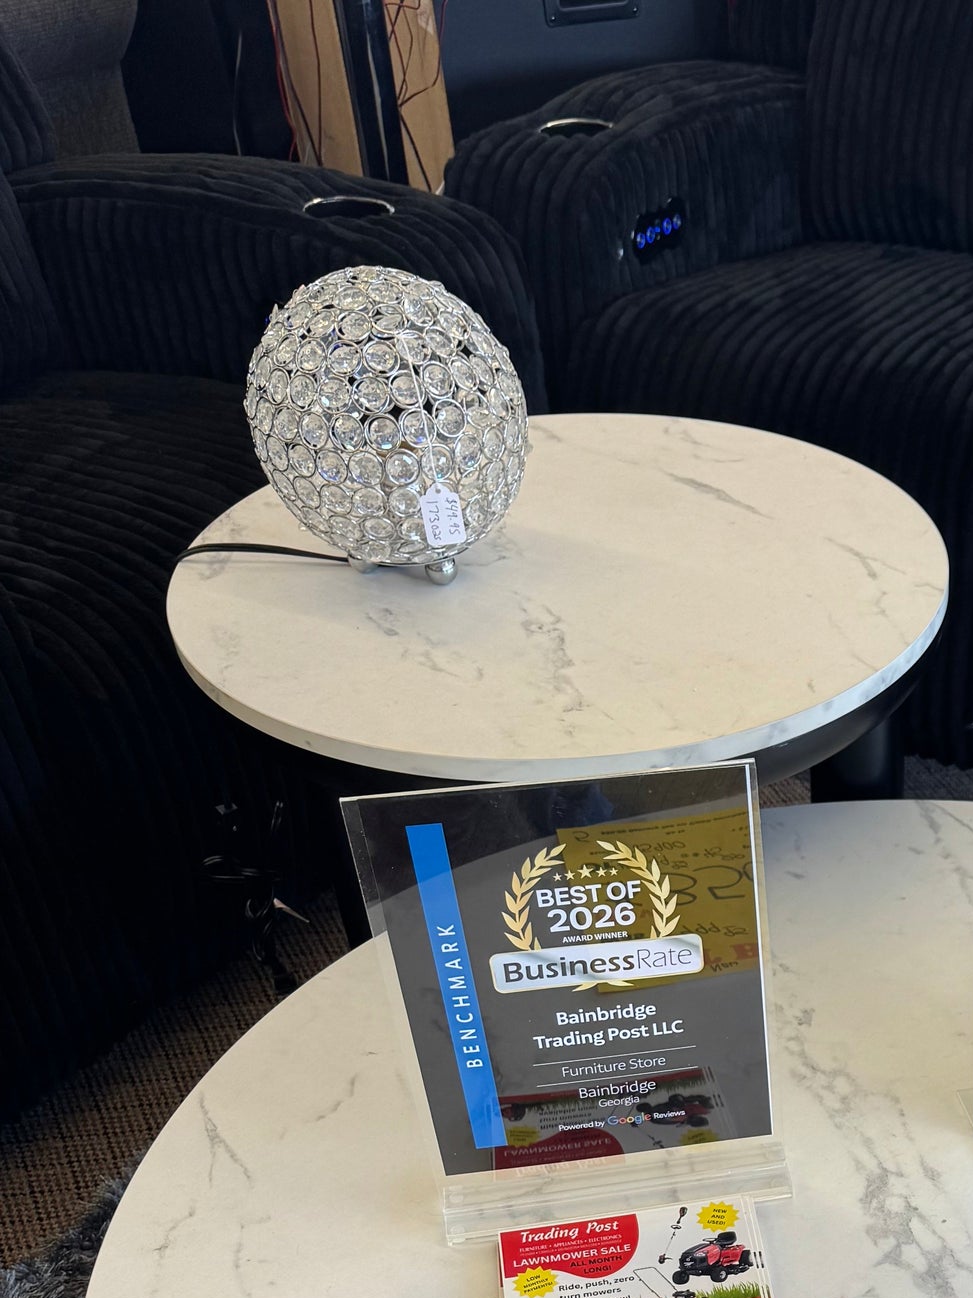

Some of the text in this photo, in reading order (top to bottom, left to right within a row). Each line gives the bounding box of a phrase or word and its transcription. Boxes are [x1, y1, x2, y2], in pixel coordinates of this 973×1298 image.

[535, 880, 643, 908] BEST OF
[547, 900, 636, 933] 2026
[562, 930, 630, 944] AWARD WINNER
[503, 948, 692, 983] BusinessRate
[436, 922, 483, 1072] BENCHMARK
[556, 1003, 656, 1026] Bainbridge
[532, 1019, 684, 1049] Trading Post LLC
[561, 1057, 666, 1078] Furniture Store
[578, 1080, 656, 1099] Bainbridge
[598, 1093, 641, 1108] Georgia
[558, 1109, 686, 1132] Powered by Google Reviews
[706, 1217, 726, 1226] USED!
[710, 1212, 726, 1222] AND
[712, 1208, 728, 1216] NEW
[520, 1220, 619, 1243] Trading Post
[513, 1248, 598, 1268] LAWNMOWER
[600, 1243, 632, 1255] SALE
[569, 1255, 623, 1268] ALL MONTH
[583, 1265, 612, 1275] LONG!
[558, 1275, 635, 1292] Ride, push, zero
[583, 1287, 622, 1298] mowers
